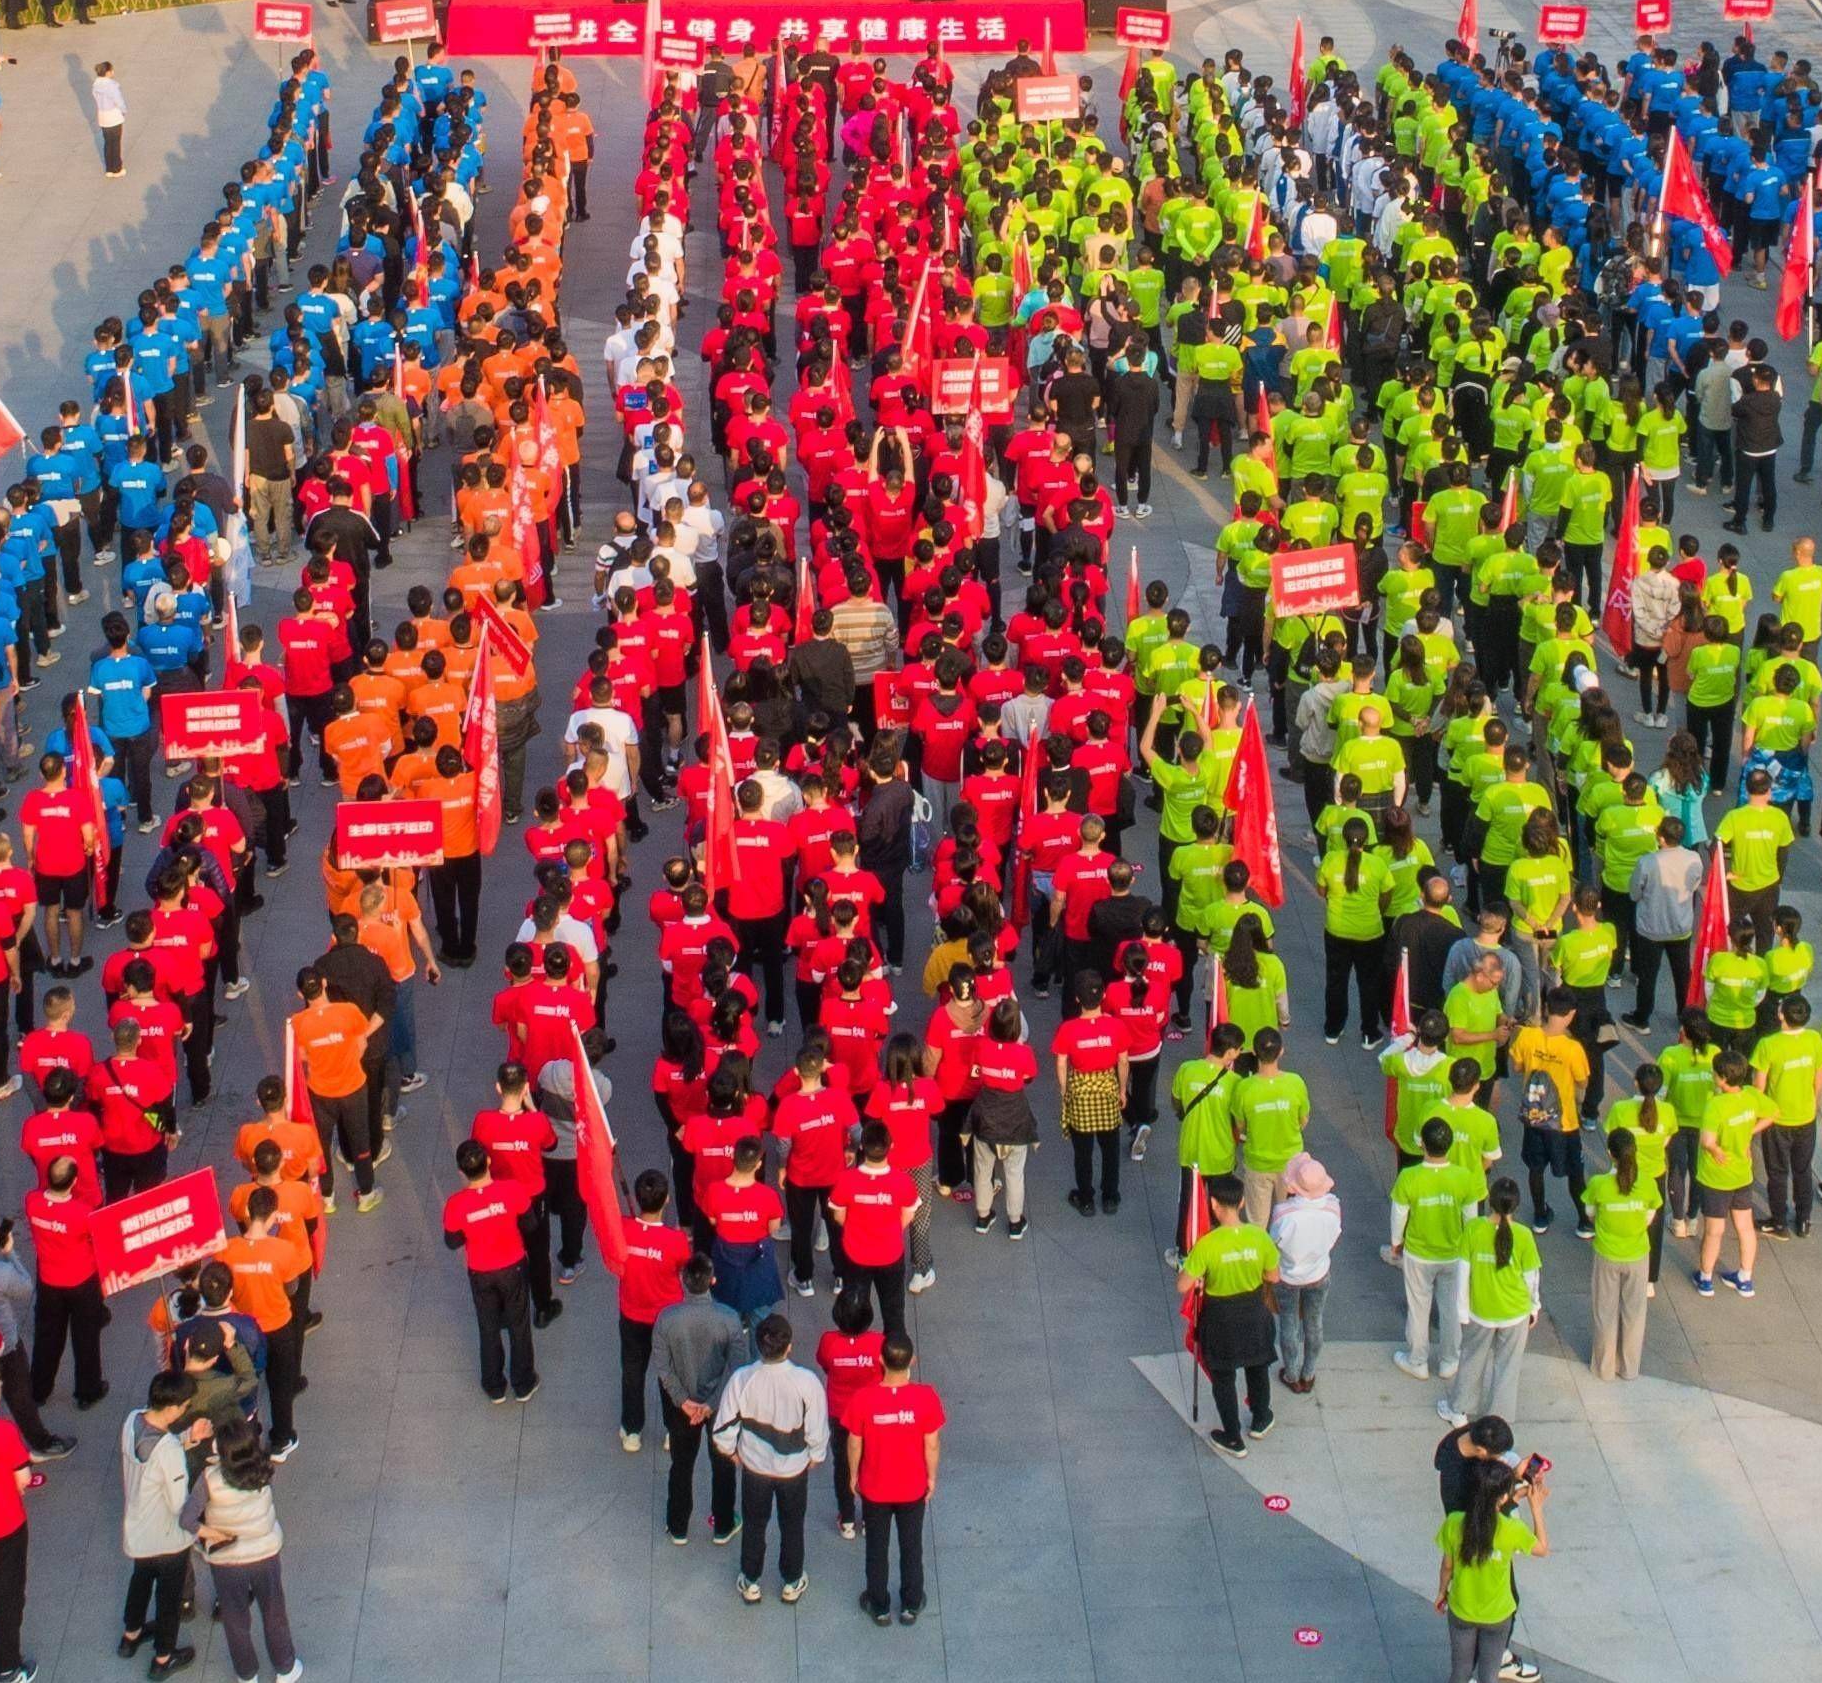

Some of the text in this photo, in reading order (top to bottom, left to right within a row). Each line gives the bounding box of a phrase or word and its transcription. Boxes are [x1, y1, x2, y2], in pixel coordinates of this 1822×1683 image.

[780, 17, 1006, 42] 共享健康生活
[348, 821, 433, 837] 生命在于运动
